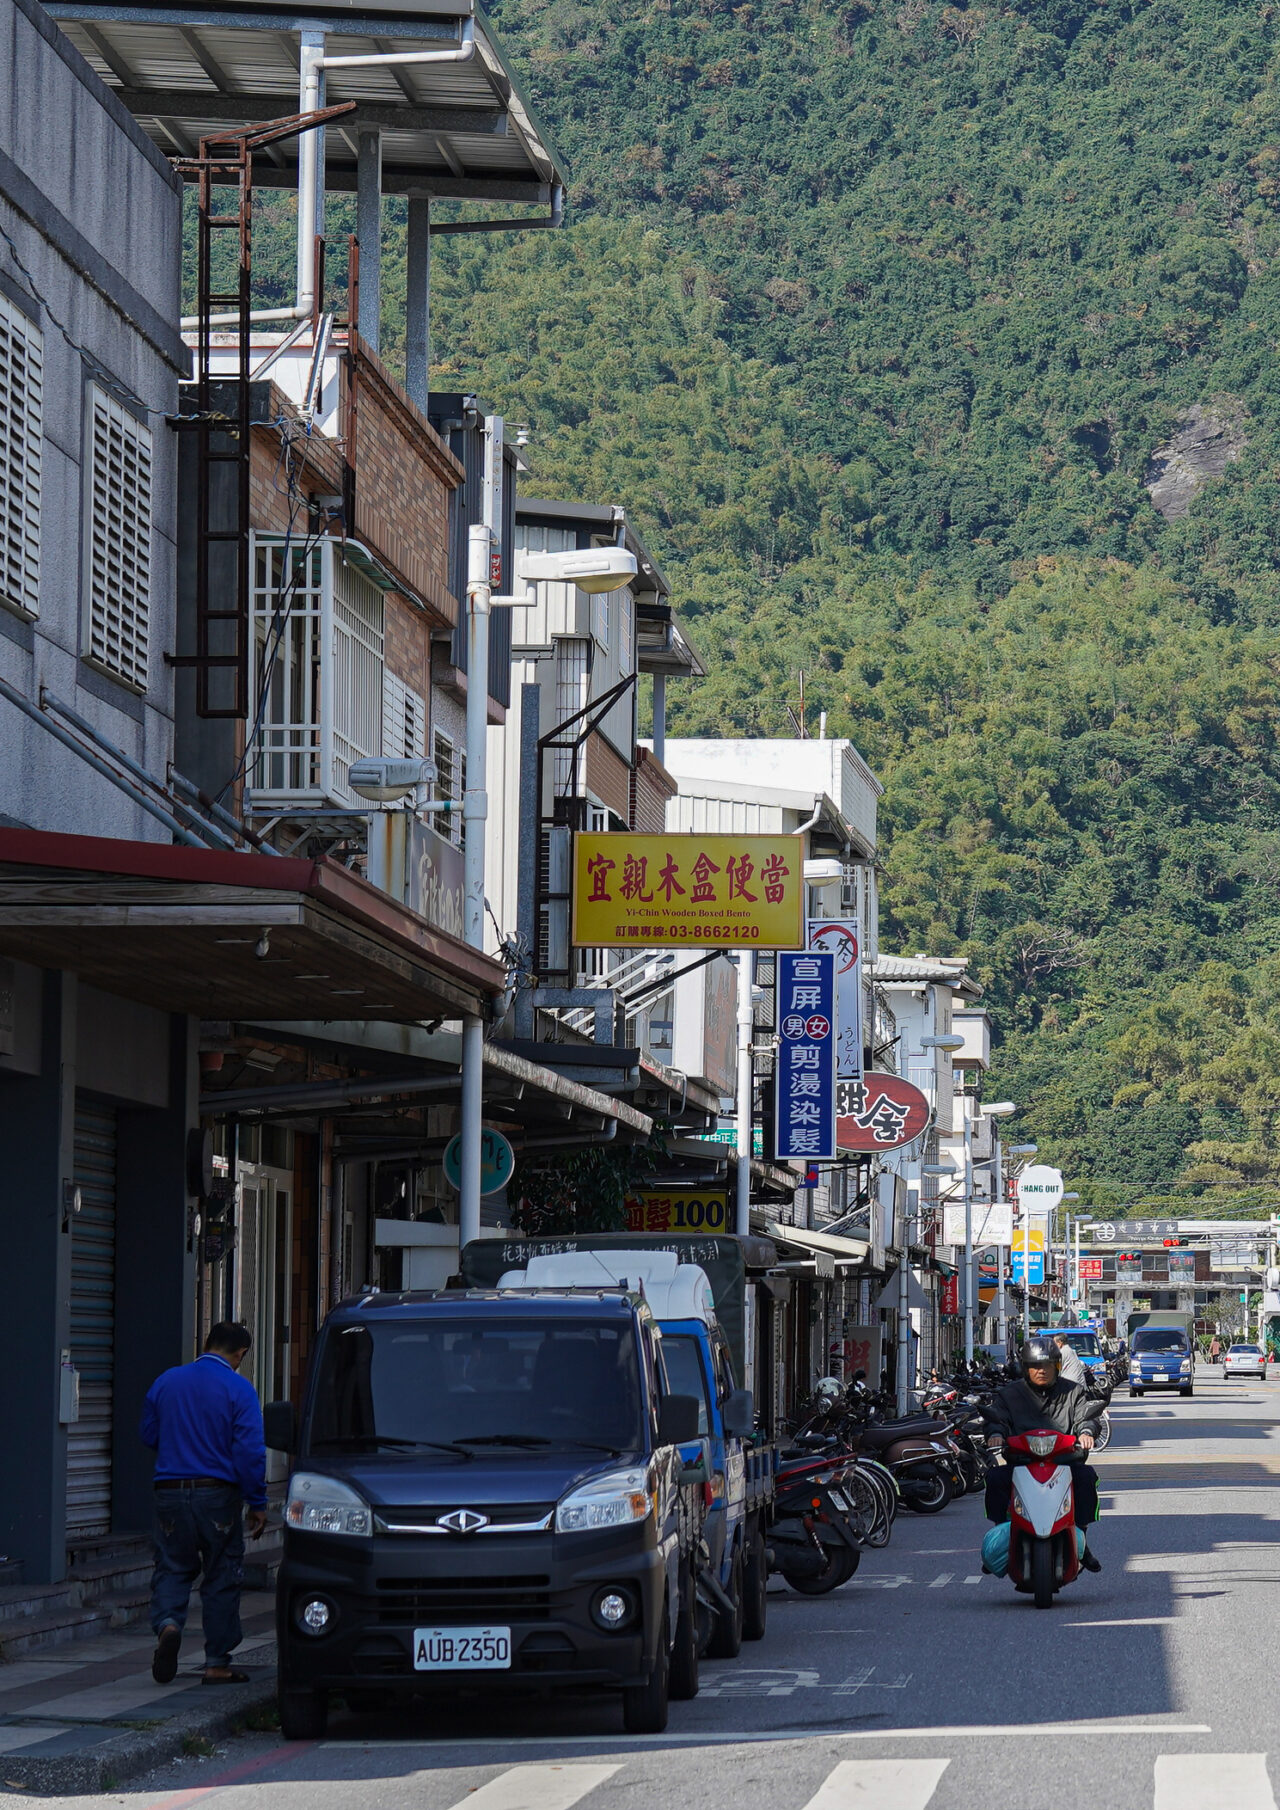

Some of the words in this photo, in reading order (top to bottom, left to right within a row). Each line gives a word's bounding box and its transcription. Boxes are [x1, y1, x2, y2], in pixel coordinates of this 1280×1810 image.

[587, 852, 790, 904] 宜親木盒便當
[626, 908, 659, 917] Yi-Chin
[662, 908, 696, 917] Wooden
[698, 908, 724, 917] Boxed
[726, 908, 751, 917] Bento
[452, 1134, 504, 1171] CME
[1045, 1185, 1059, 1193] OUT
[674, 1200, 724, 1228] 100
